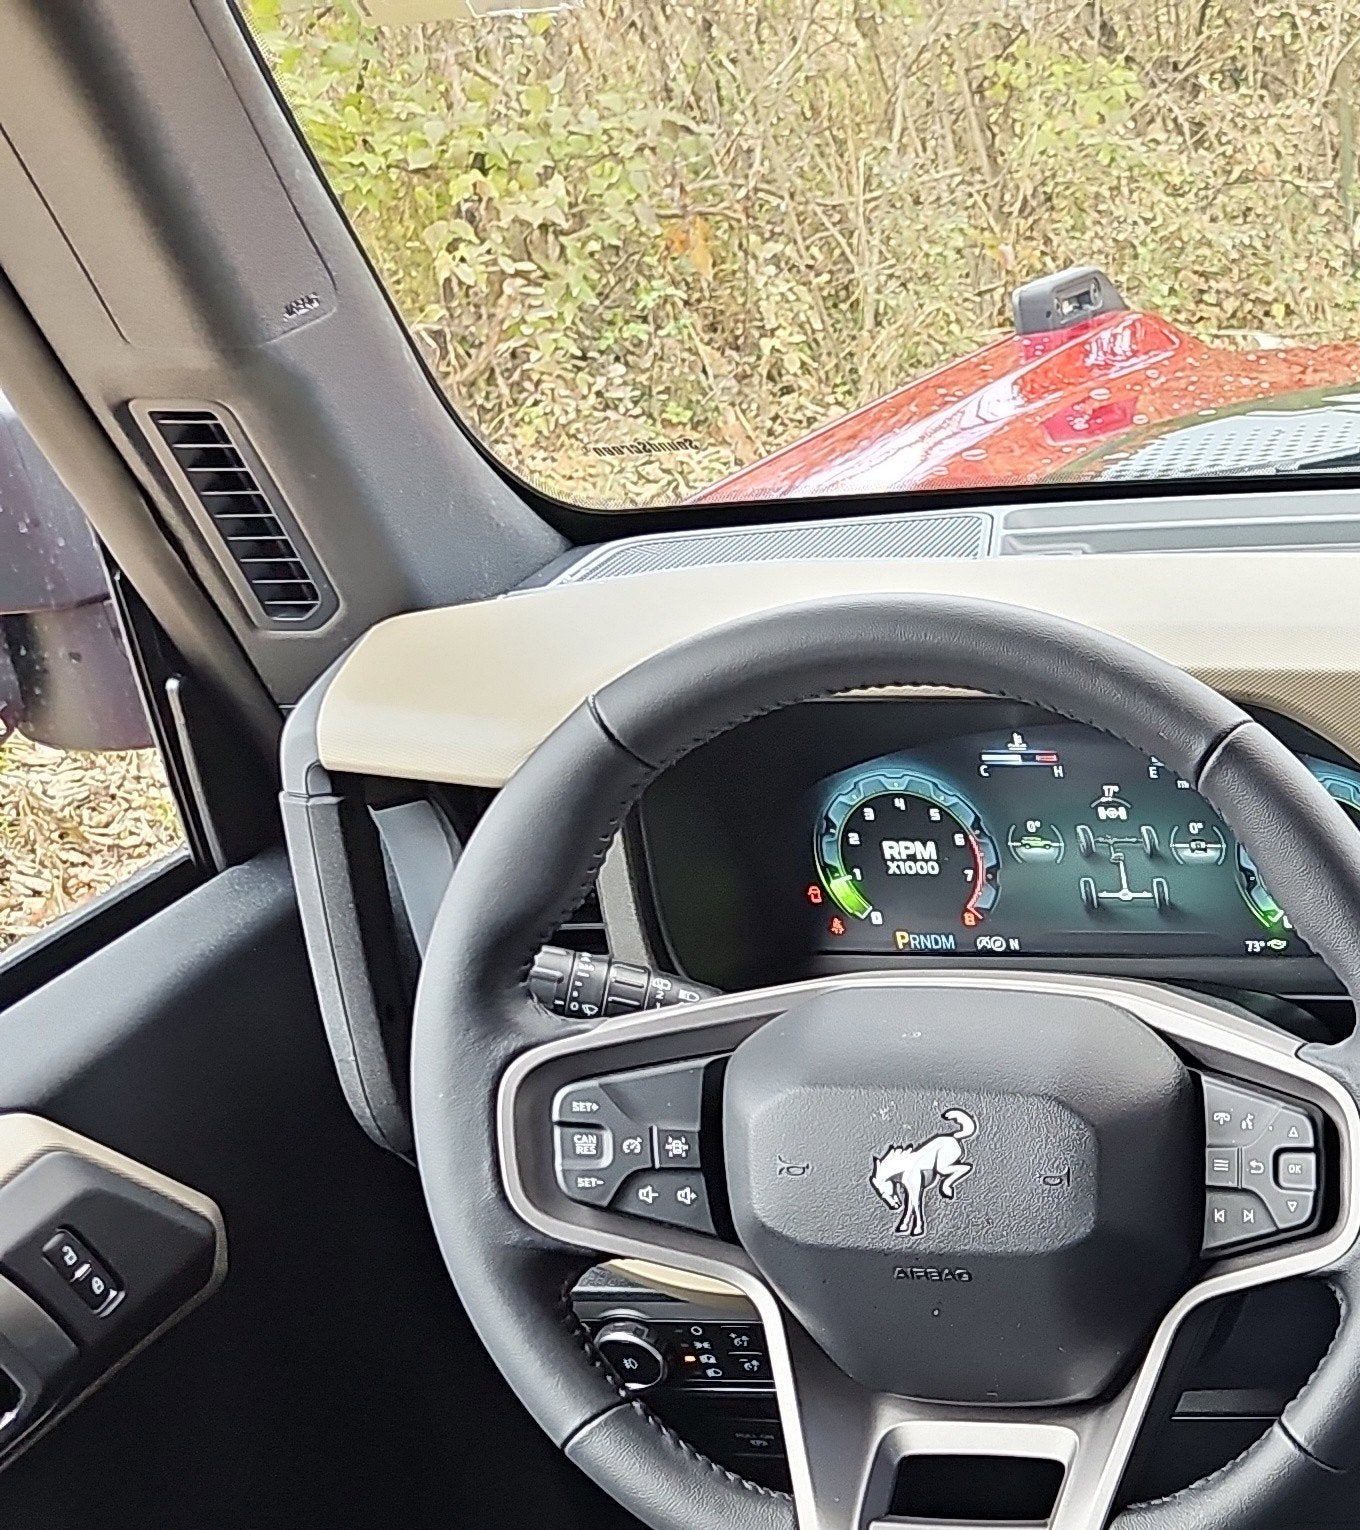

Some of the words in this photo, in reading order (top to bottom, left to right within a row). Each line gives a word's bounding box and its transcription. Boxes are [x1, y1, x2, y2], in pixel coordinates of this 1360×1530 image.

[979, 765, 990, 777] C
[1053, 766, 1064, 778] H
[1149, 767, 1159, 779] E
[894, 797, 906, 810] 4
[863, 808, 875, 821] 3
[929, 808, 941, 821] 5
[849, 832, 860, 845] 2
[953, 832, 965, 846] 6
[881, 840, 937, 860] RPM
[852, 868, 862, 881] 1
[886, 861, 940, 875] X1000
[963, 869, 973, 882] 7
[895, 931, 956, 950] PRNDM
[1009, 938, 1020, 950] N
[573, 1134, 597, 1144] CAN
[575, 1144, 597, 1155] RES
[1288, 1164, 1302, 1174] OK
[893, 1265, 973, 1282] AIRBAG
